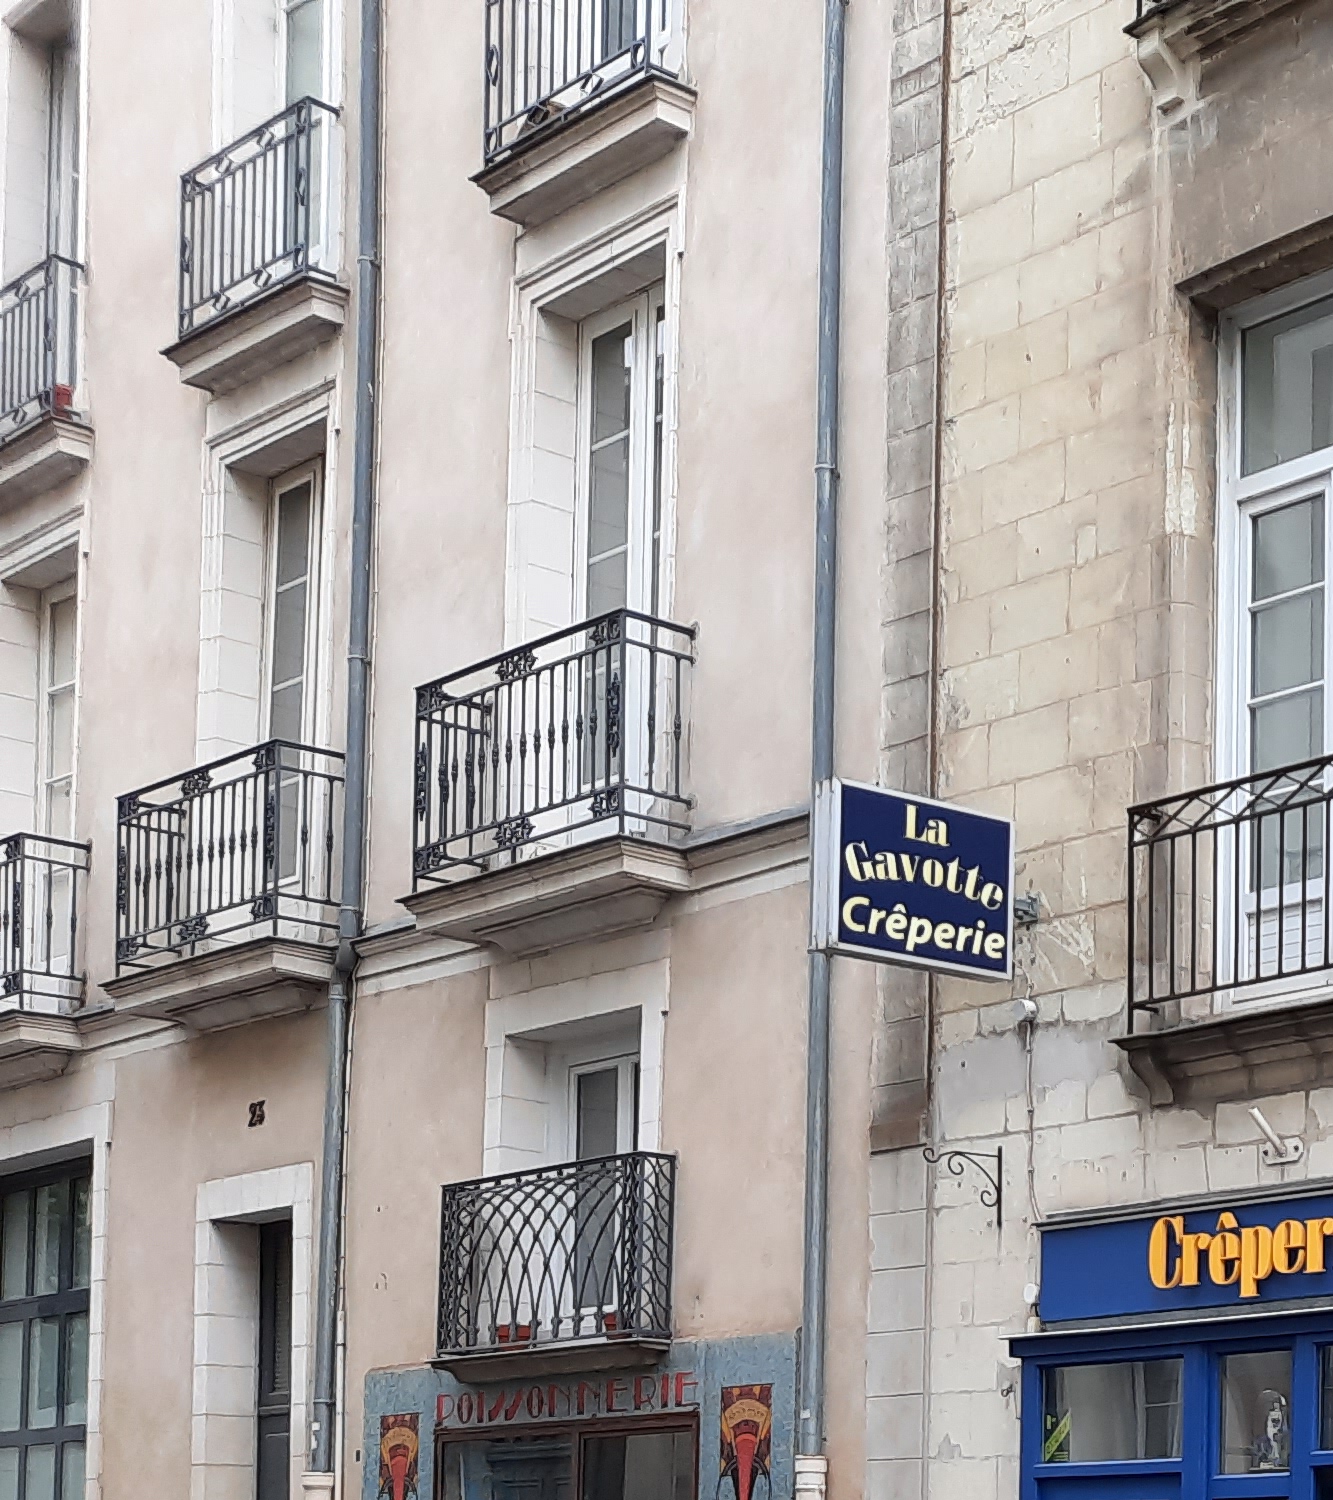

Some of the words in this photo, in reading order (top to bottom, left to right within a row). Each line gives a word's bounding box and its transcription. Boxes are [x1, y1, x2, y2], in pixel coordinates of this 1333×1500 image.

[904, 804, 950, 847] La
[845, 841, 1004, 911] Gavotte
[842, 896, 1006, 959] Crêperie
[436, 1371, 699, 1426] POISSONNERIE
